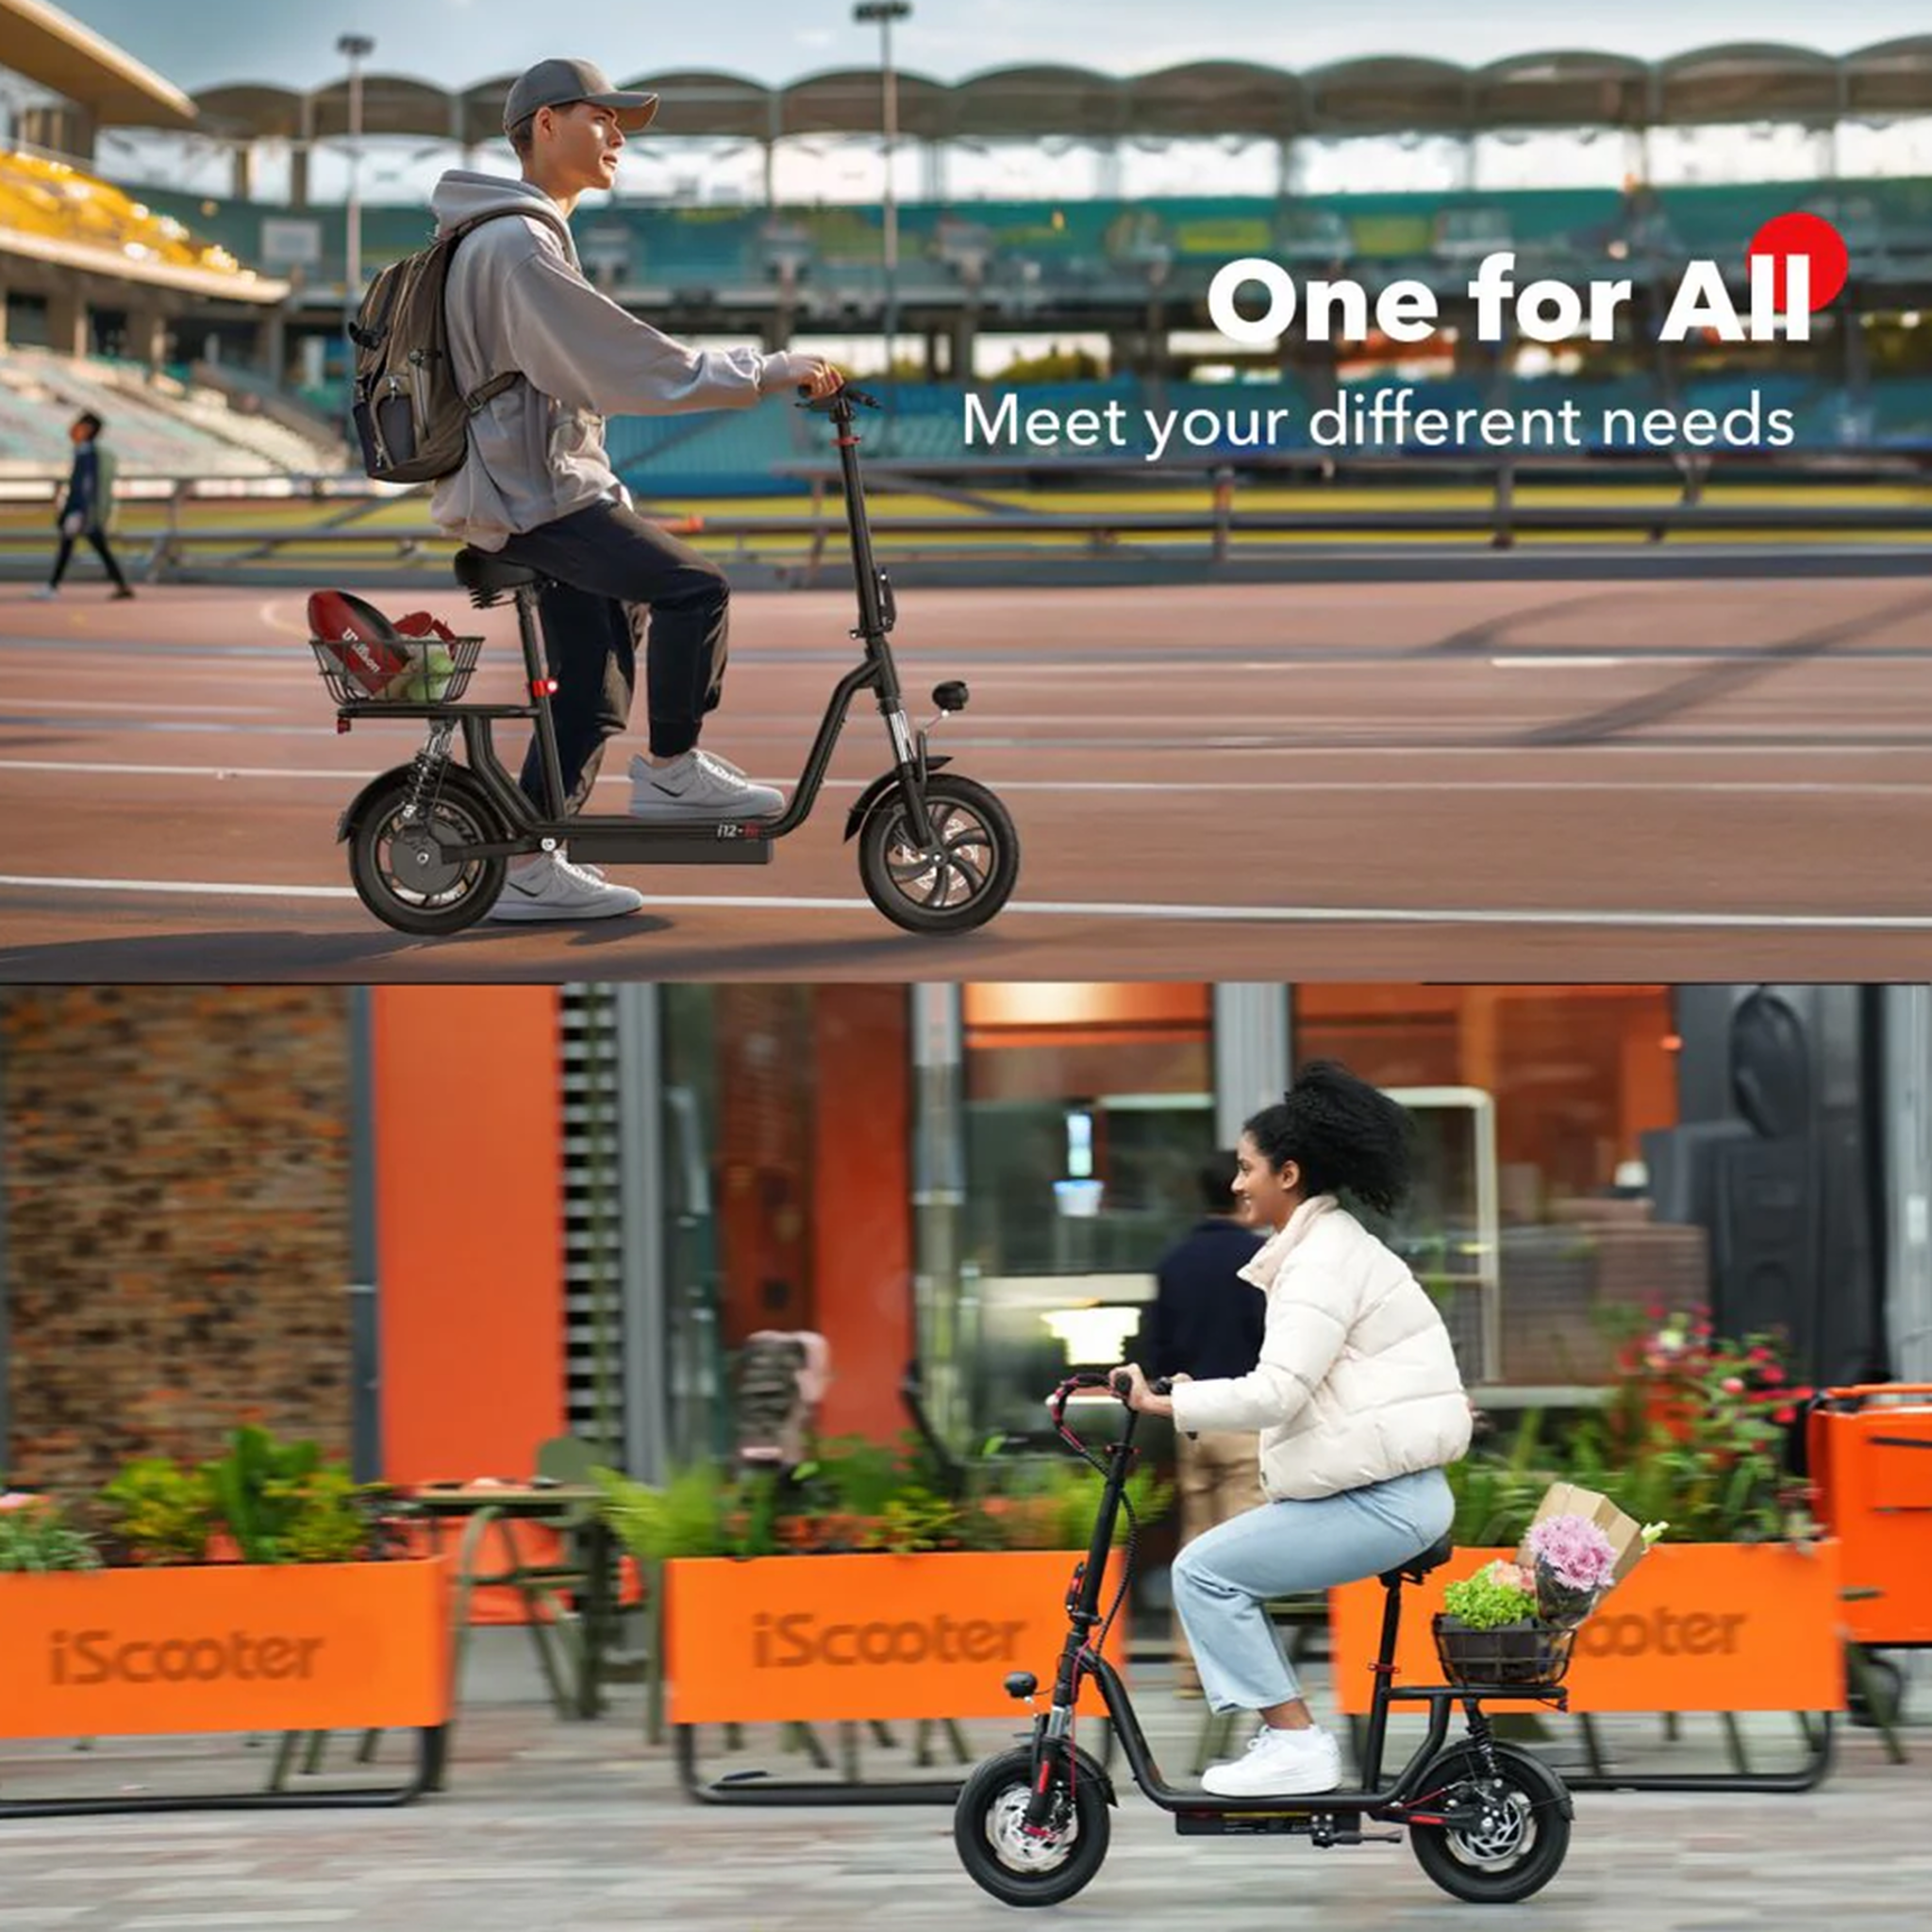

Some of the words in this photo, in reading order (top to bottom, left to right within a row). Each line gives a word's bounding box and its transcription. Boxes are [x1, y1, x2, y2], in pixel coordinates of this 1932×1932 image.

[48, 1628, 325, 1686] iScooter
[754, 1611, 1026, 1668] iScooter
[1574, 1607, 1746, 1657] ooter
